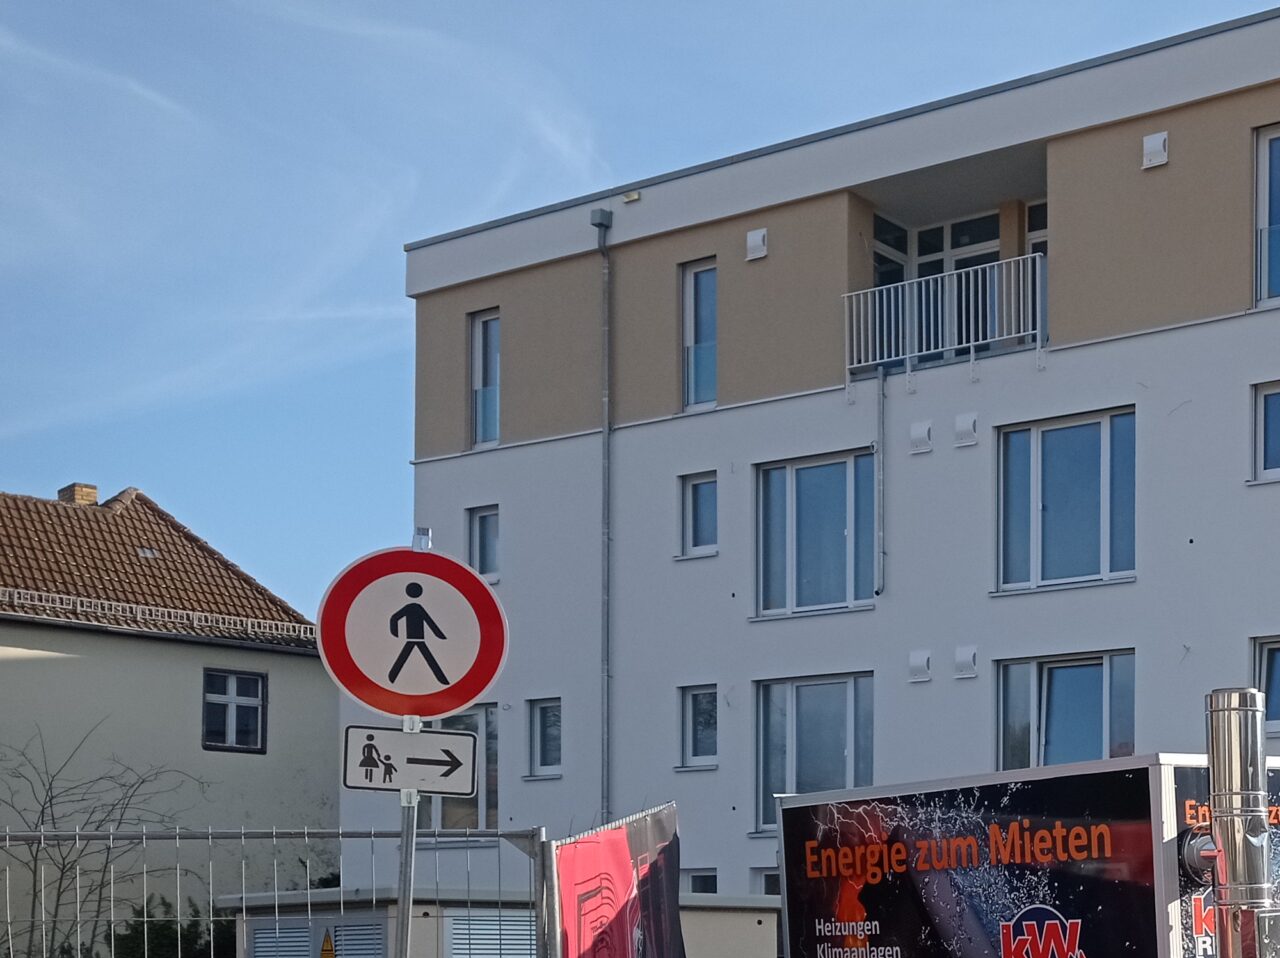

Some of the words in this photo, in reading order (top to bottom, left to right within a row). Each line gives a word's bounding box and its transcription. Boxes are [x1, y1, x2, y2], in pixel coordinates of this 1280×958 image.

[805, 834, 907, 883] Energie
[915, 836, 979, 871] zum
[988, 819, 1112, 865] Mieten
[815, 917, 880, 938] Heizungen
